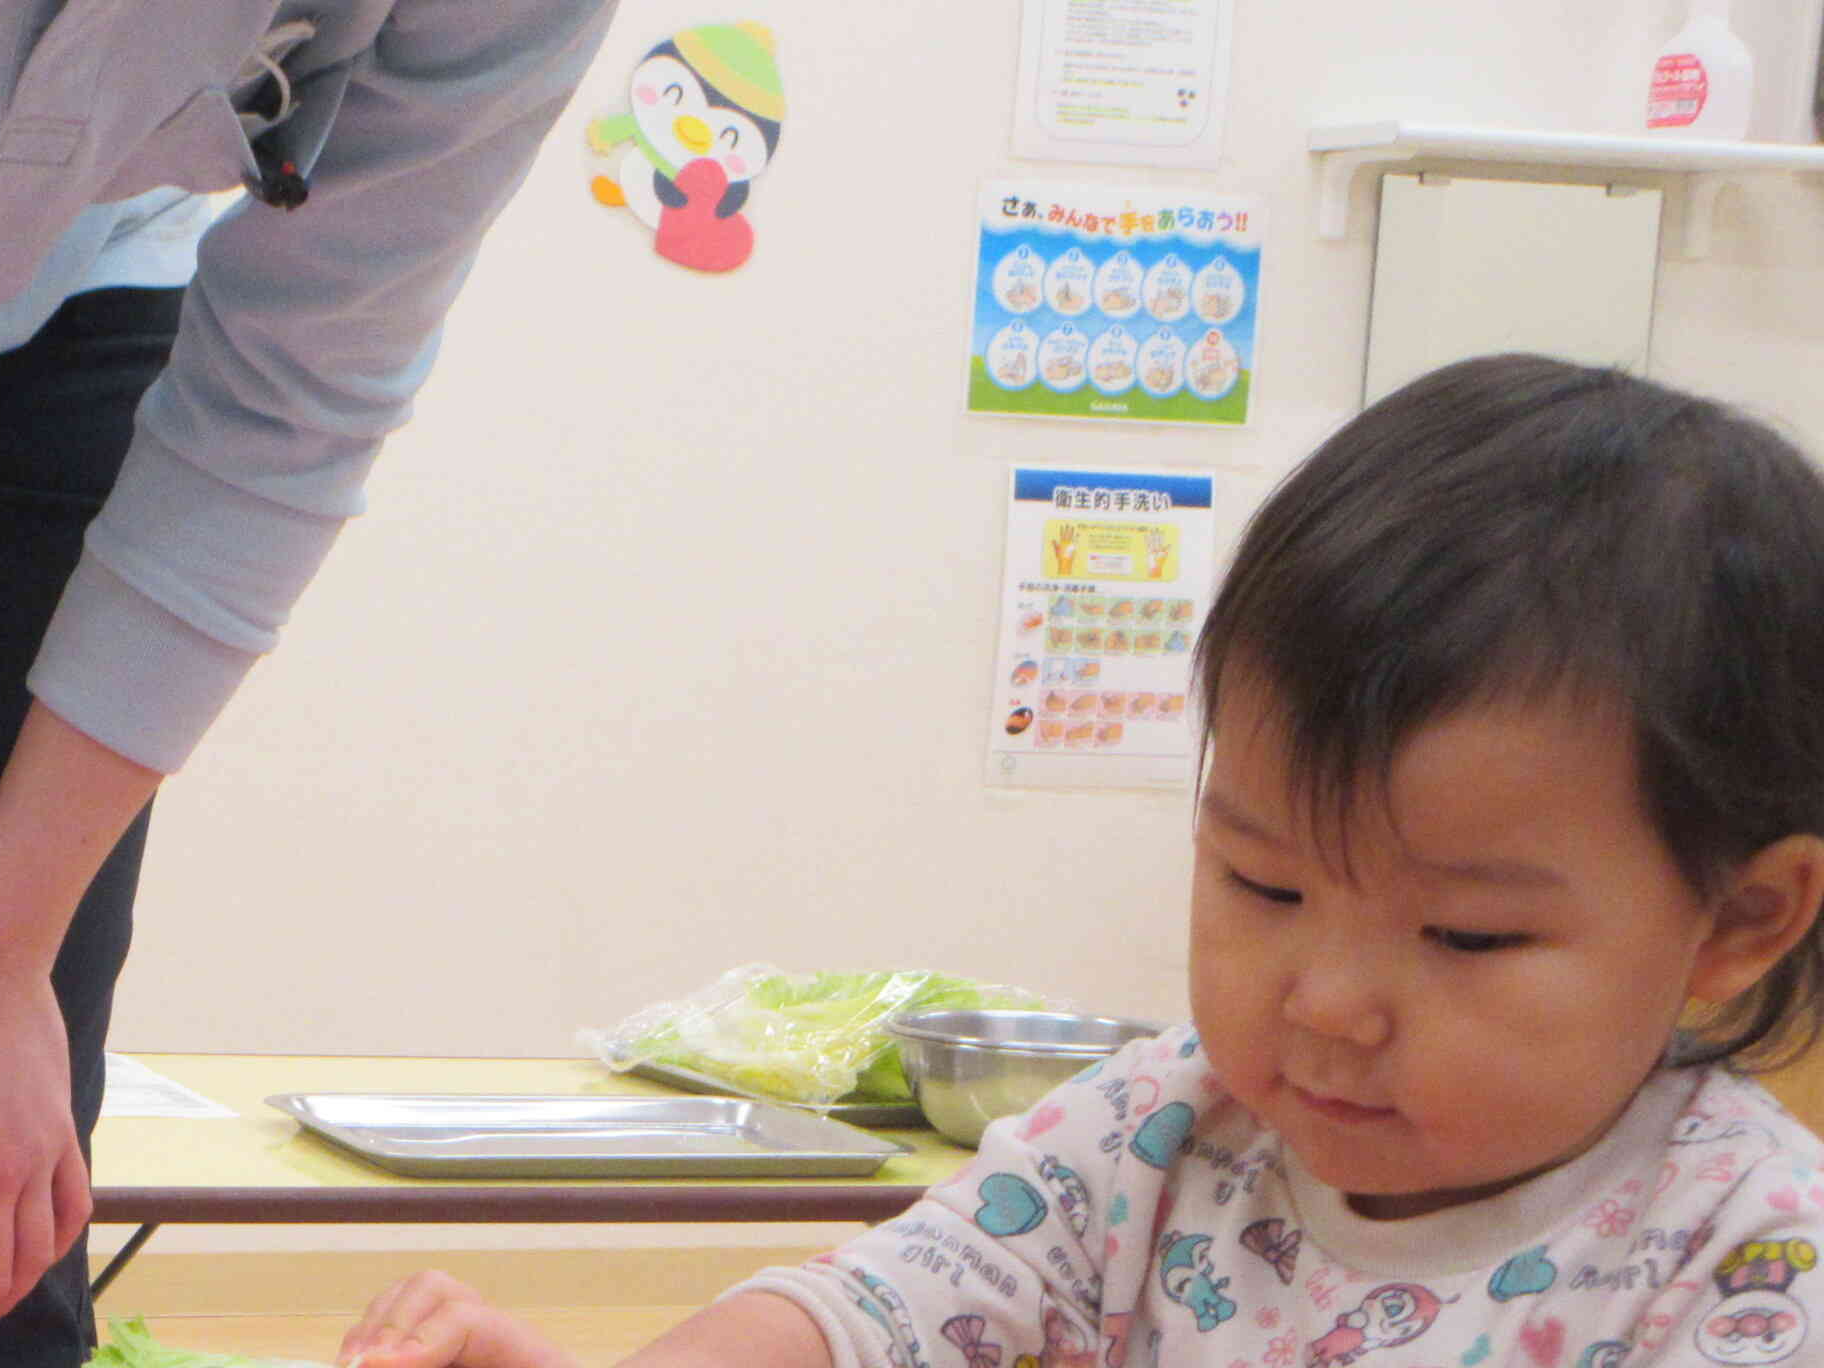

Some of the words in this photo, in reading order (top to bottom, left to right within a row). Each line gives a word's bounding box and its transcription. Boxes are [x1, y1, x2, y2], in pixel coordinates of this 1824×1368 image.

[1055, 488, 1169, 511] 衛生的手洗い
